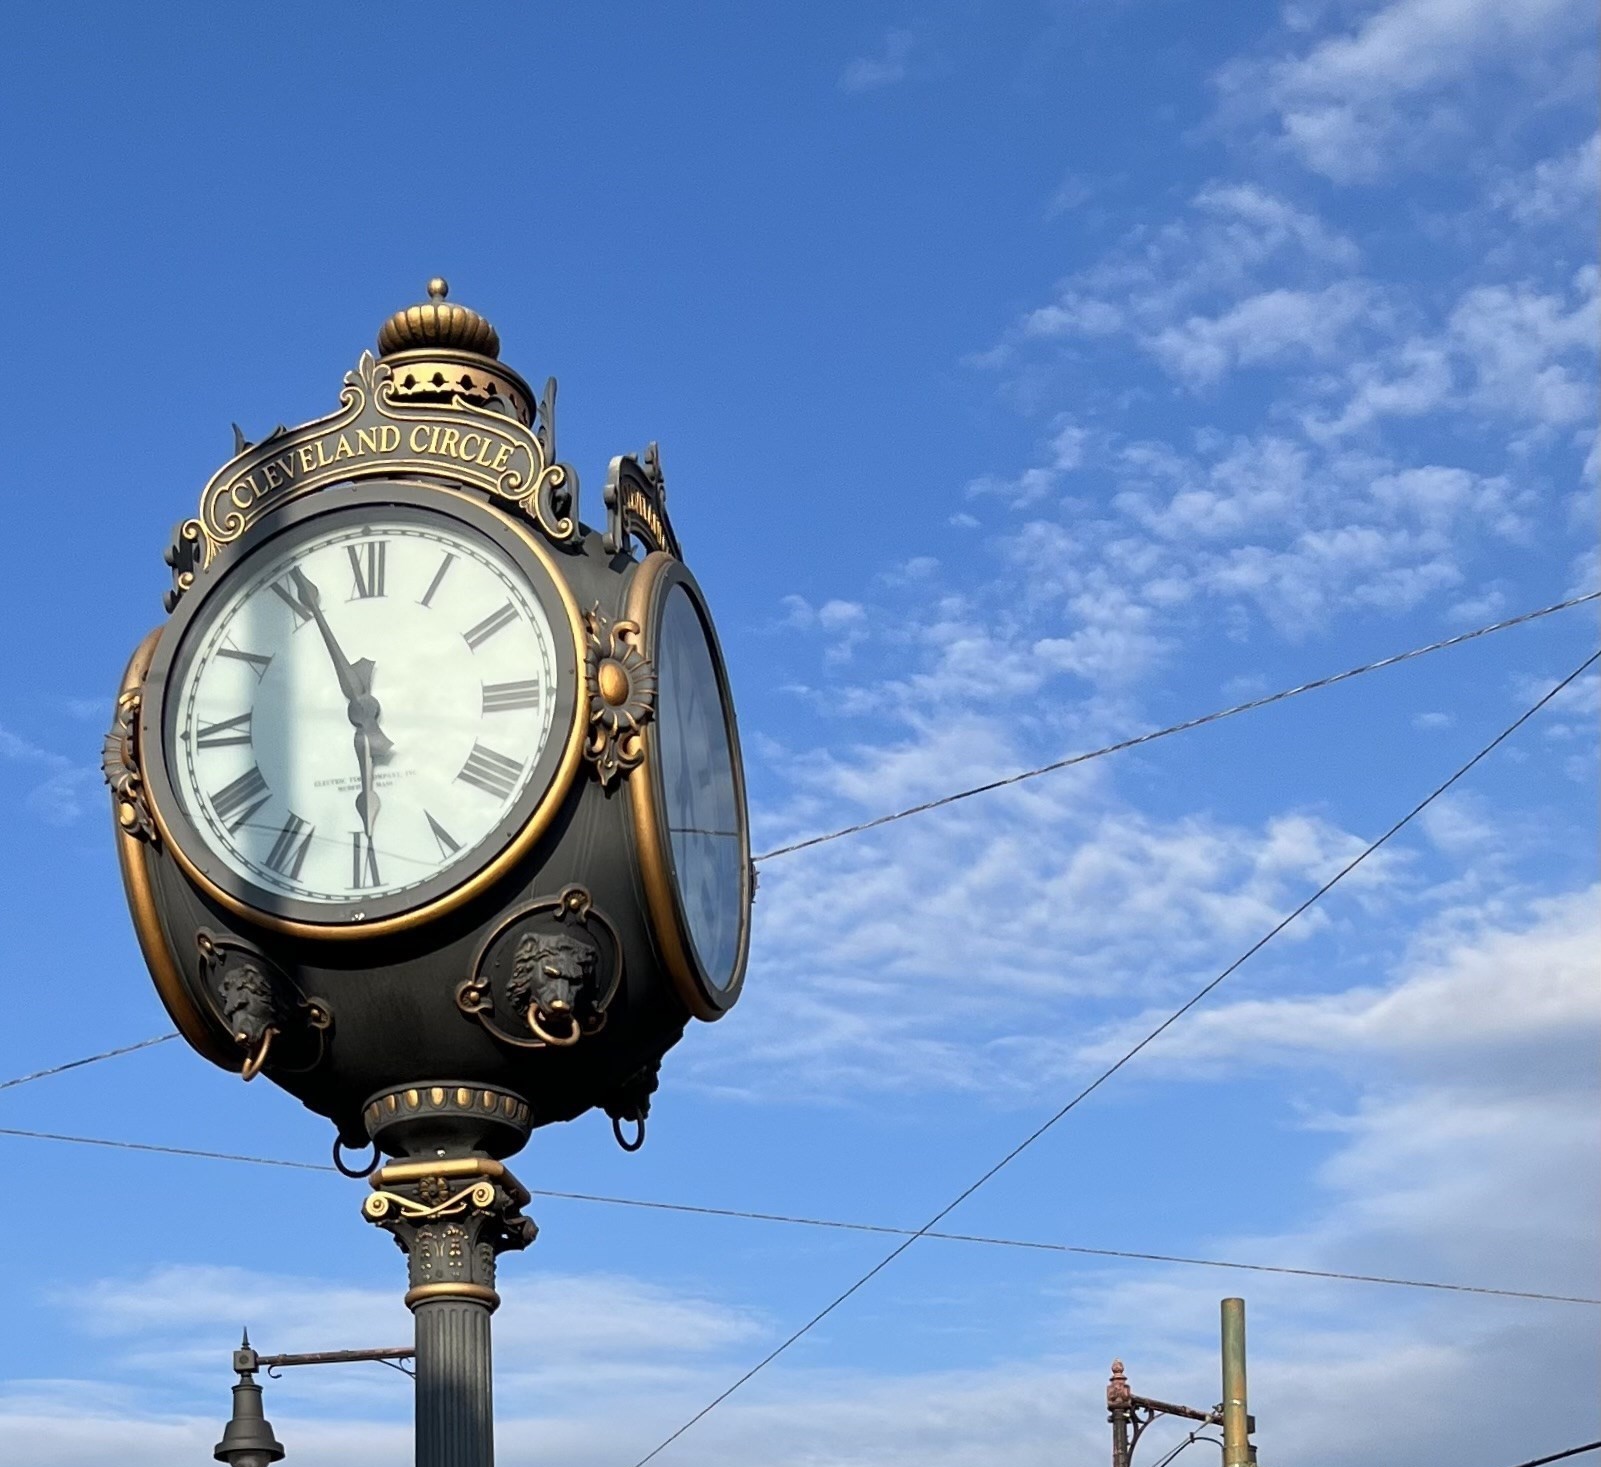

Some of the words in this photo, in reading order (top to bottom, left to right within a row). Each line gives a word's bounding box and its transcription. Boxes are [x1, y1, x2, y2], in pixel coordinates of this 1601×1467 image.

[231, 425, 400, 509] CLEVELAND
[409, 424, 514, 472] CIRCLE
[342, 540, 391, 603] XII
[415, 549, 460, 609] I
[460, 597, 523, 654] II
[212, 631, 275, 685] X
[481, 672, 540, 718] III
[197, 705, 253, 755] IX
[452, 737, 528, 808] IIII
[345, 831, 389, 890] VI
[424, 809, 467, 861] V
